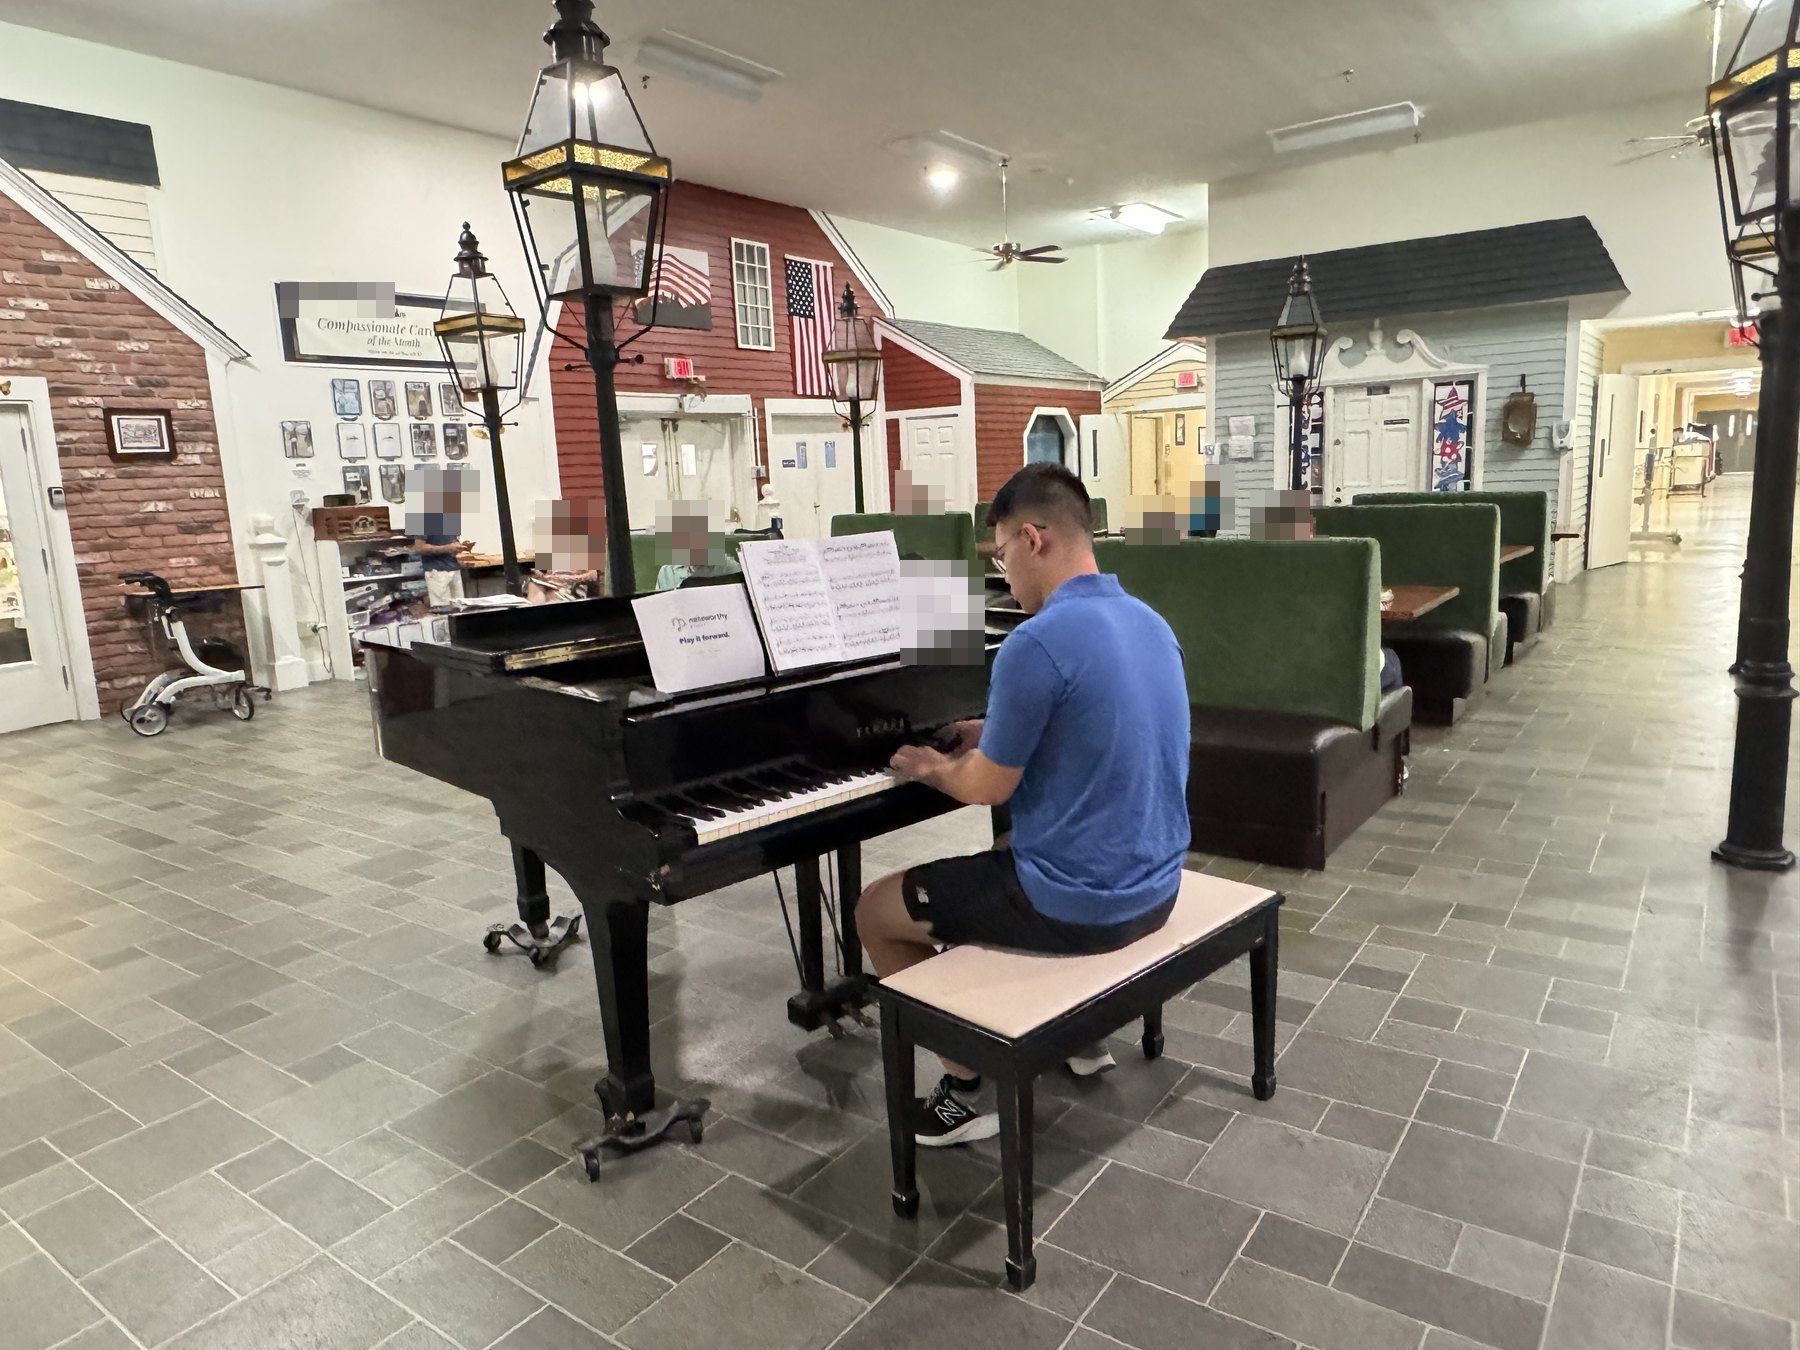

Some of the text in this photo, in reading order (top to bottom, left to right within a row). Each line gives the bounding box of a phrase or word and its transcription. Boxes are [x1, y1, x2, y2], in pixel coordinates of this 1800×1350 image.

[317, 317, 406, 335] Compassionate
[366, 335, 421, 349] of the Month
[679, 636, 695, 645] Play
